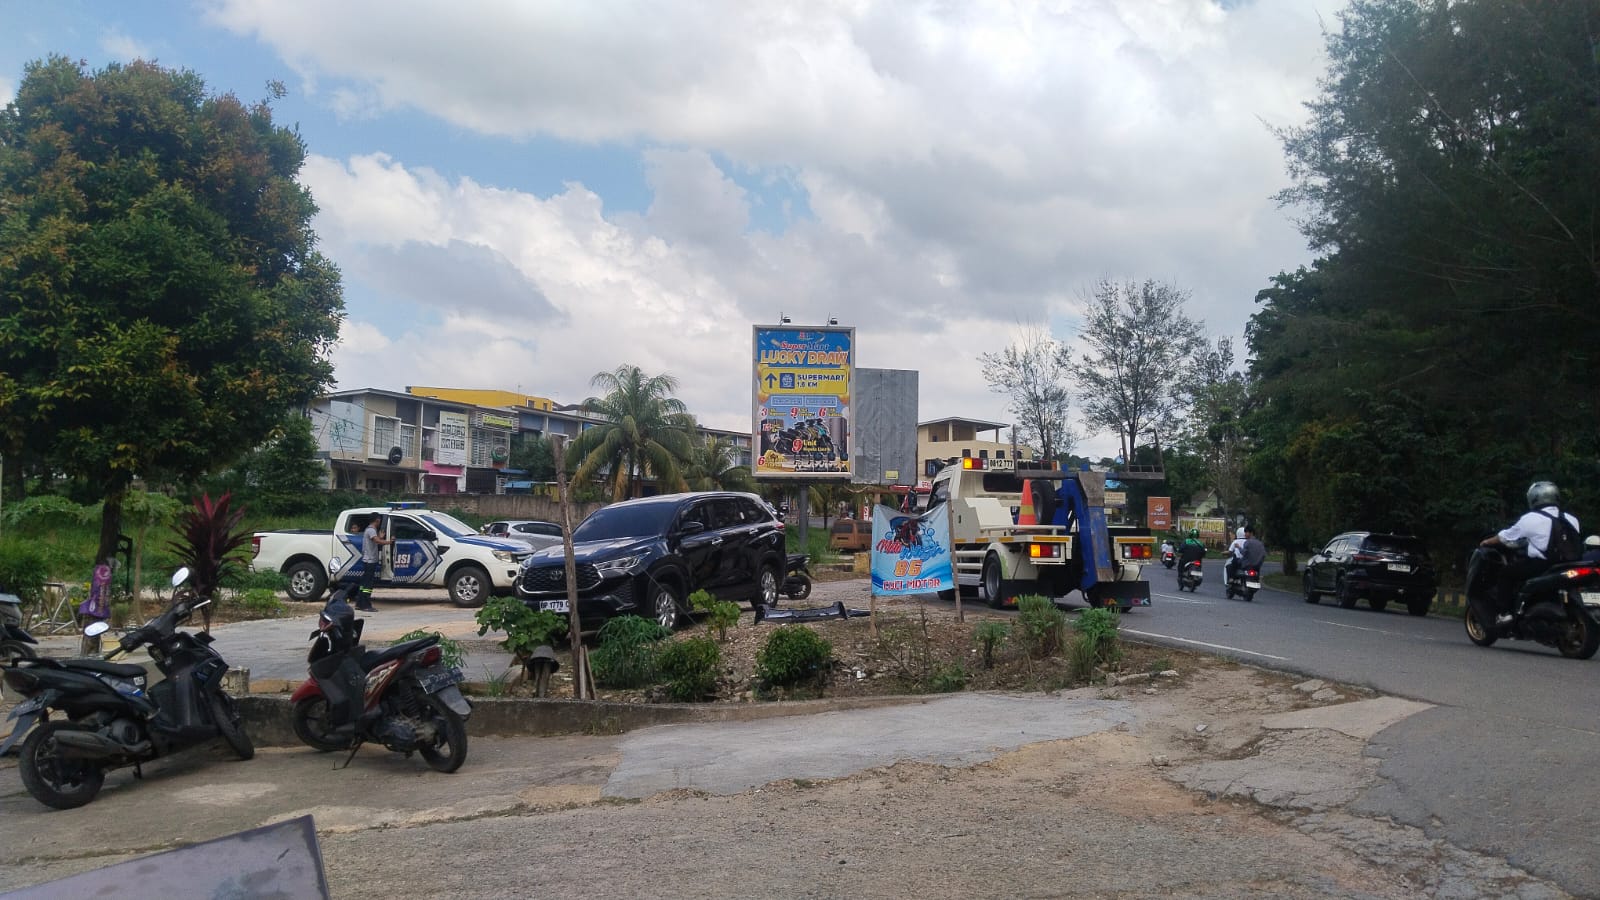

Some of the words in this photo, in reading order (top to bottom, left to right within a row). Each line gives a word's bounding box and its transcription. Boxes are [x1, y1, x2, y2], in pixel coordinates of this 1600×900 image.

[760, 350, 807, 364] LUCKY
[808, 351, 849, 365] DRAW
[797, 374, 845, 382] SUPERMART
[792, 439, 803, 452] 9
